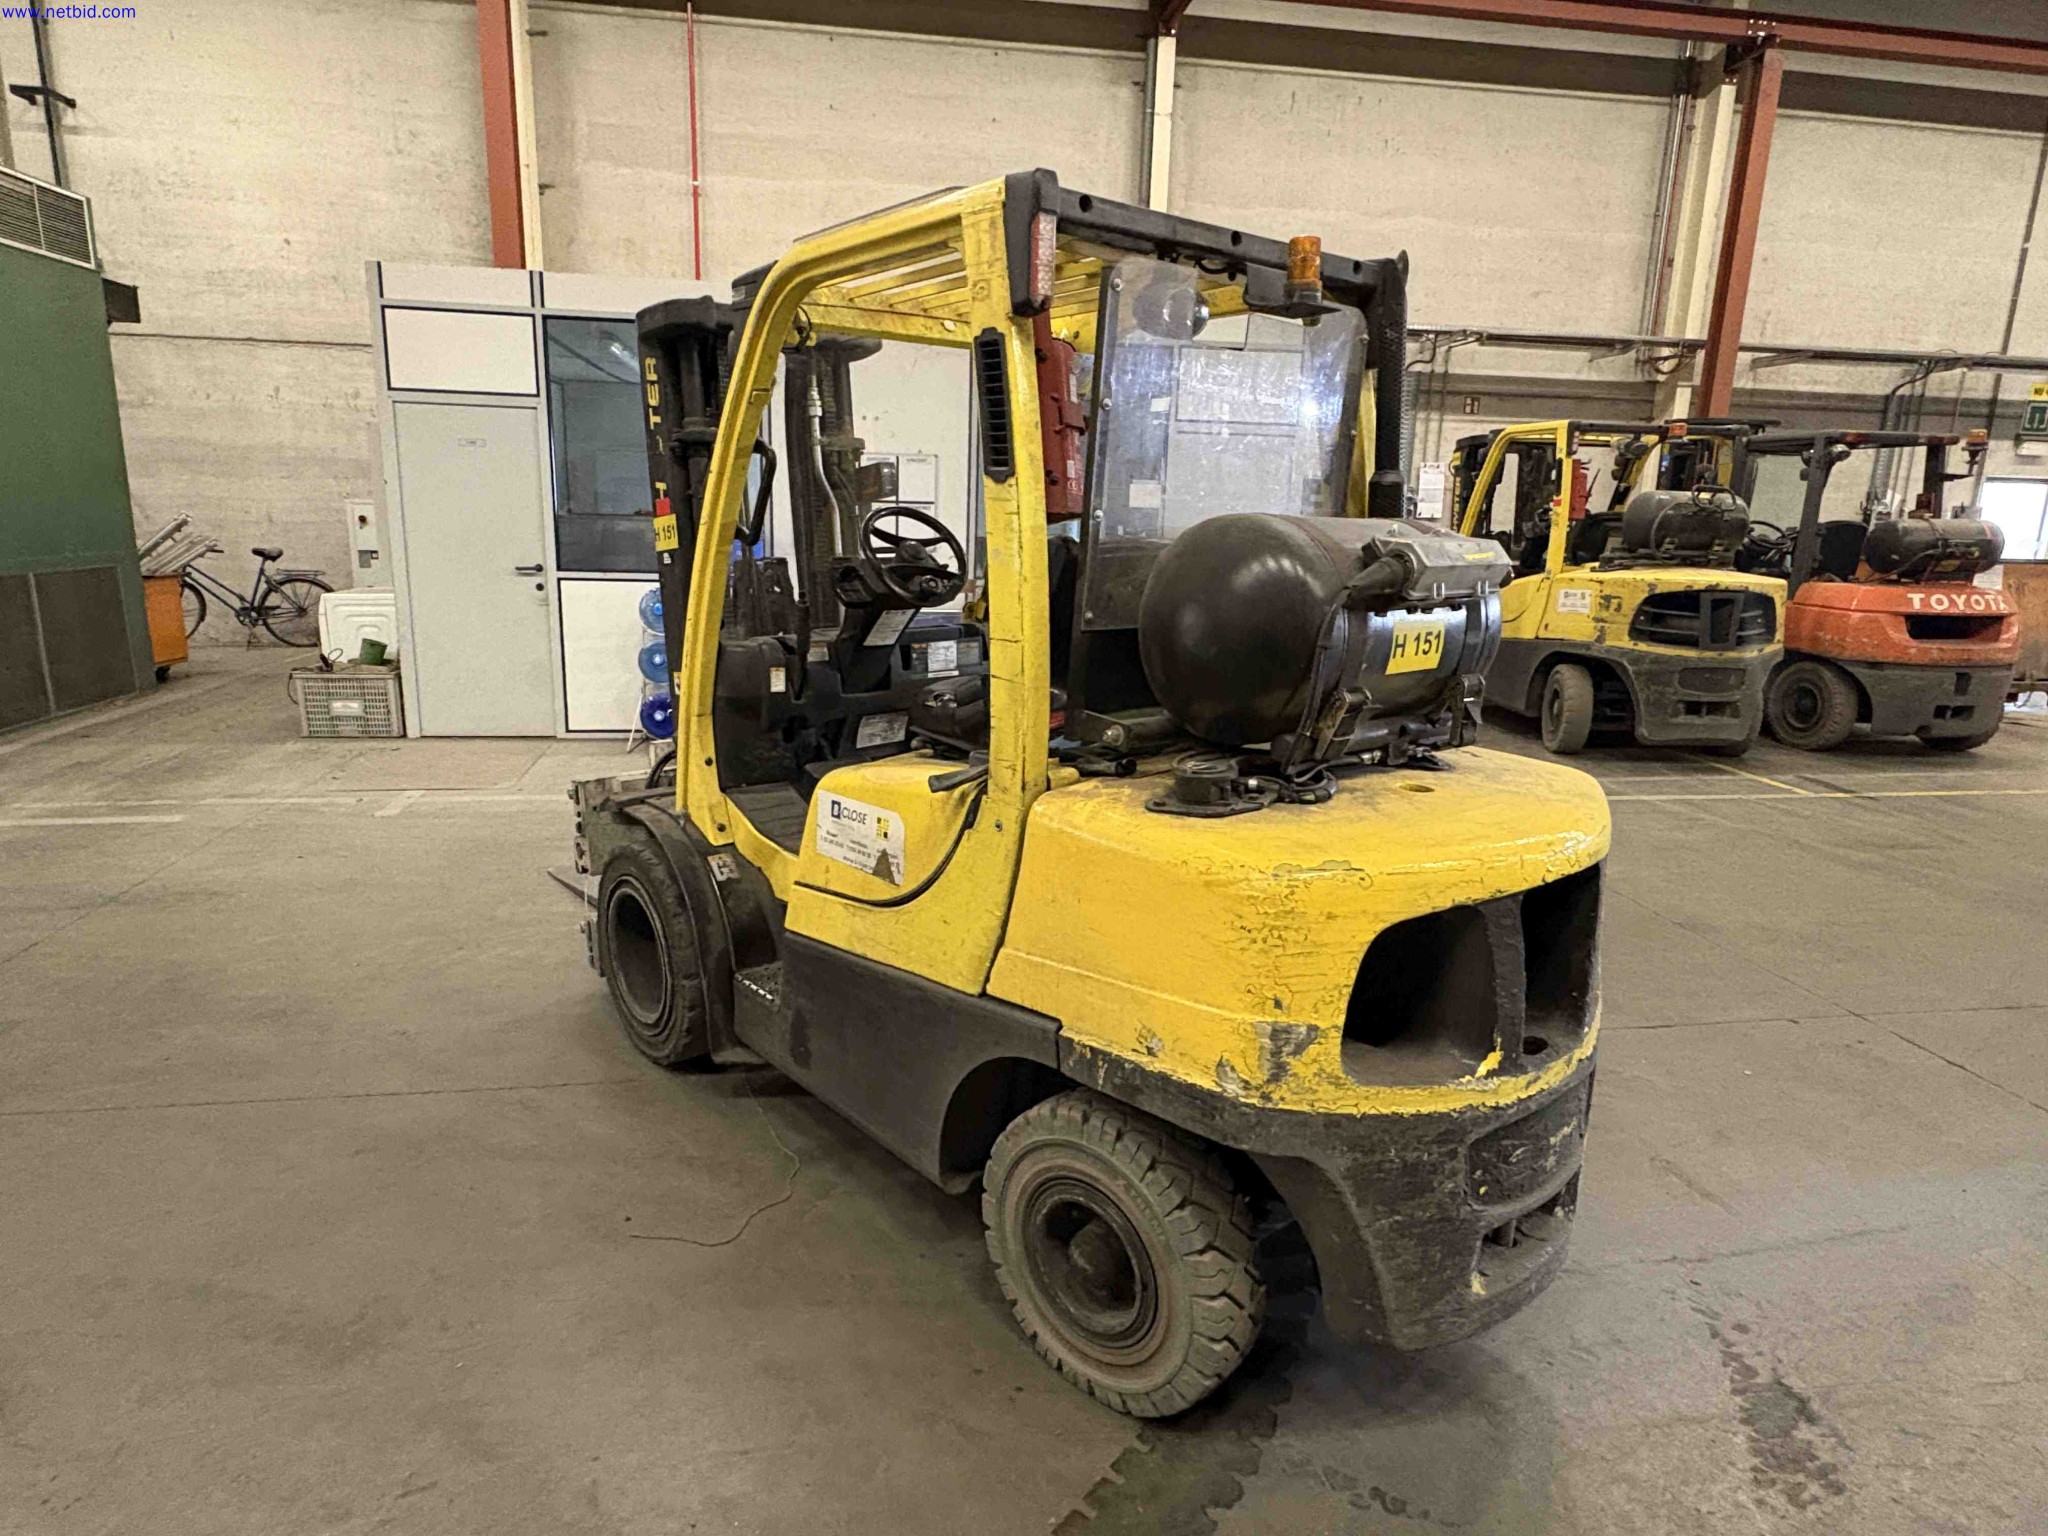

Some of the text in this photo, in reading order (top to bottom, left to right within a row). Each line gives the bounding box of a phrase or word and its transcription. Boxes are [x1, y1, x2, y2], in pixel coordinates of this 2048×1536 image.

[662, 523, 676, 541] 151
[1392, 629, 1442, 659] H 151
